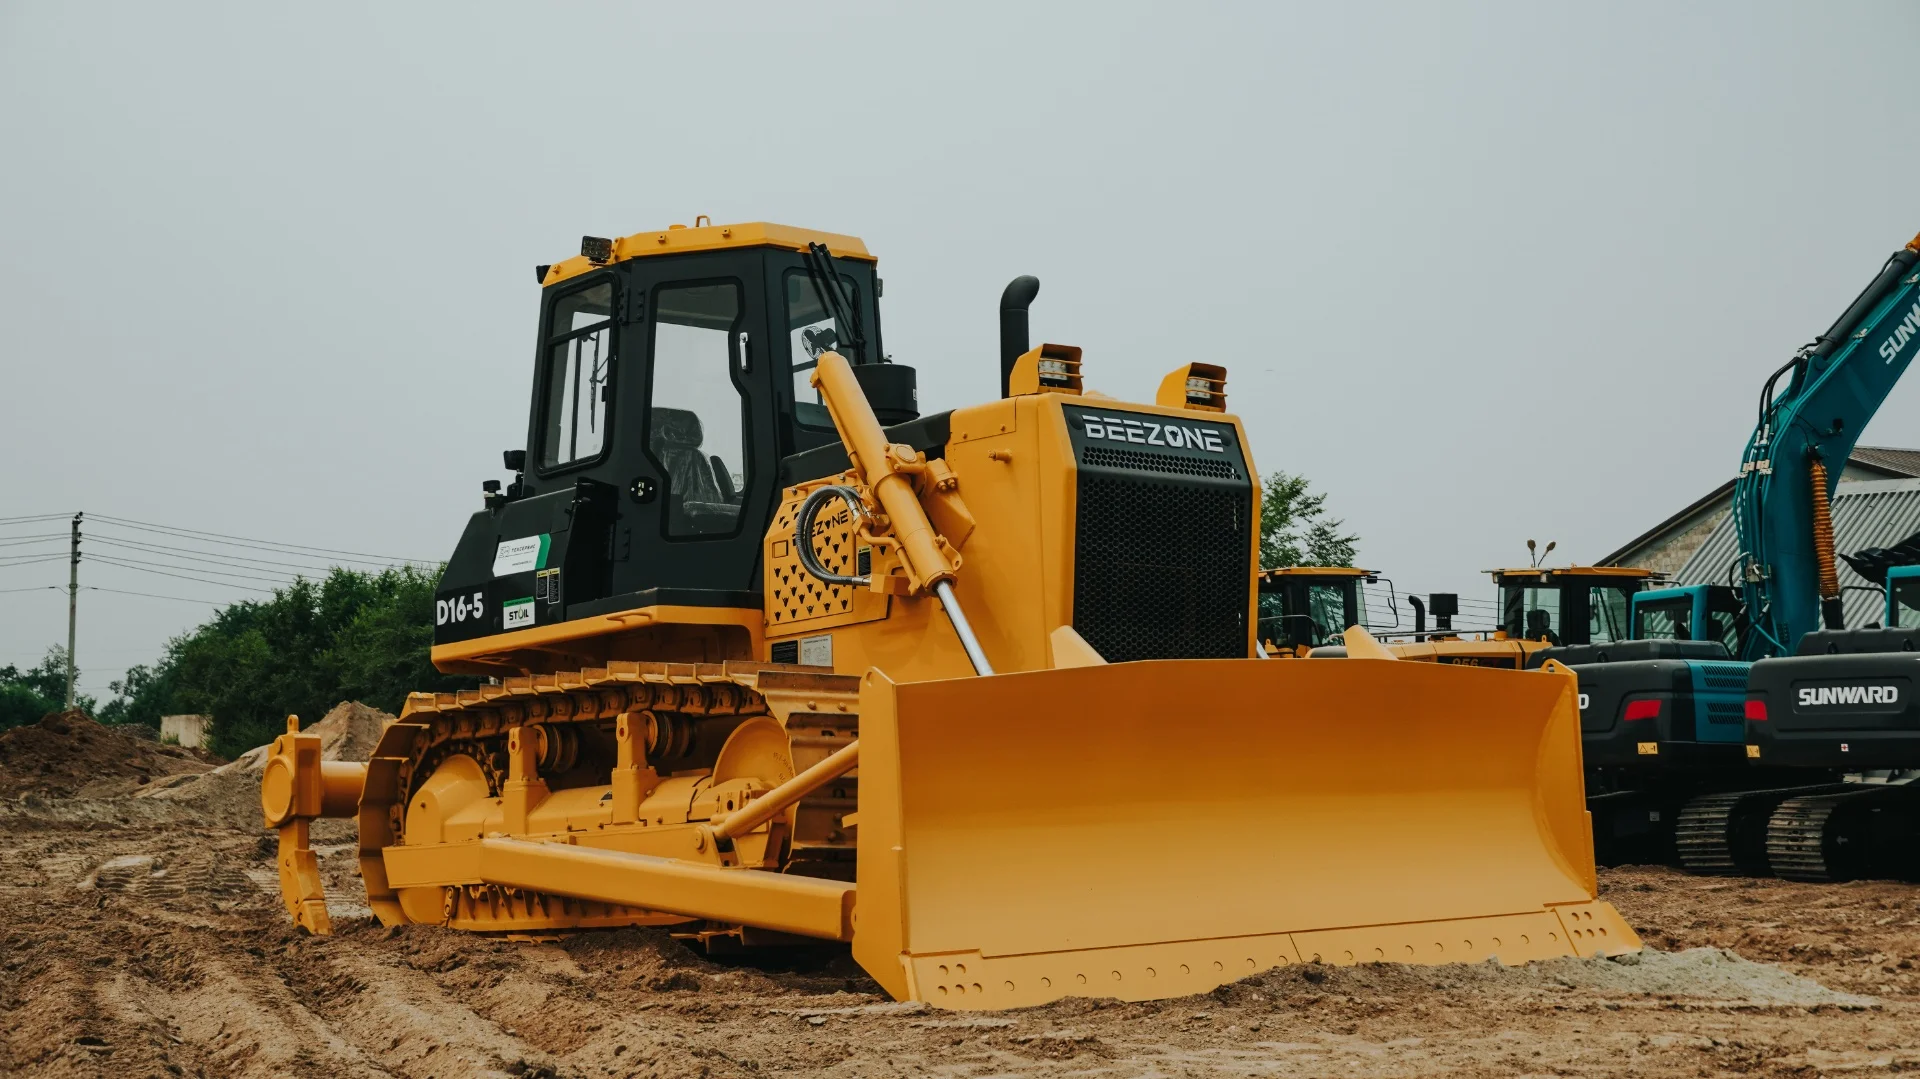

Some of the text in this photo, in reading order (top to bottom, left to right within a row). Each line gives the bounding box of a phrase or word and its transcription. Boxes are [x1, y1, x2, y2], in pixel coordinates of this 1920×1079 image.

[1879, 288, 1920, 365] SUNW
[1082, 415, 1224, 452] BEEZONE
[436, 592, 484, 626] D16-5
[509, 607, 529, 621] STOIL
[1799, 686, 1898, 706] SUNWARD
